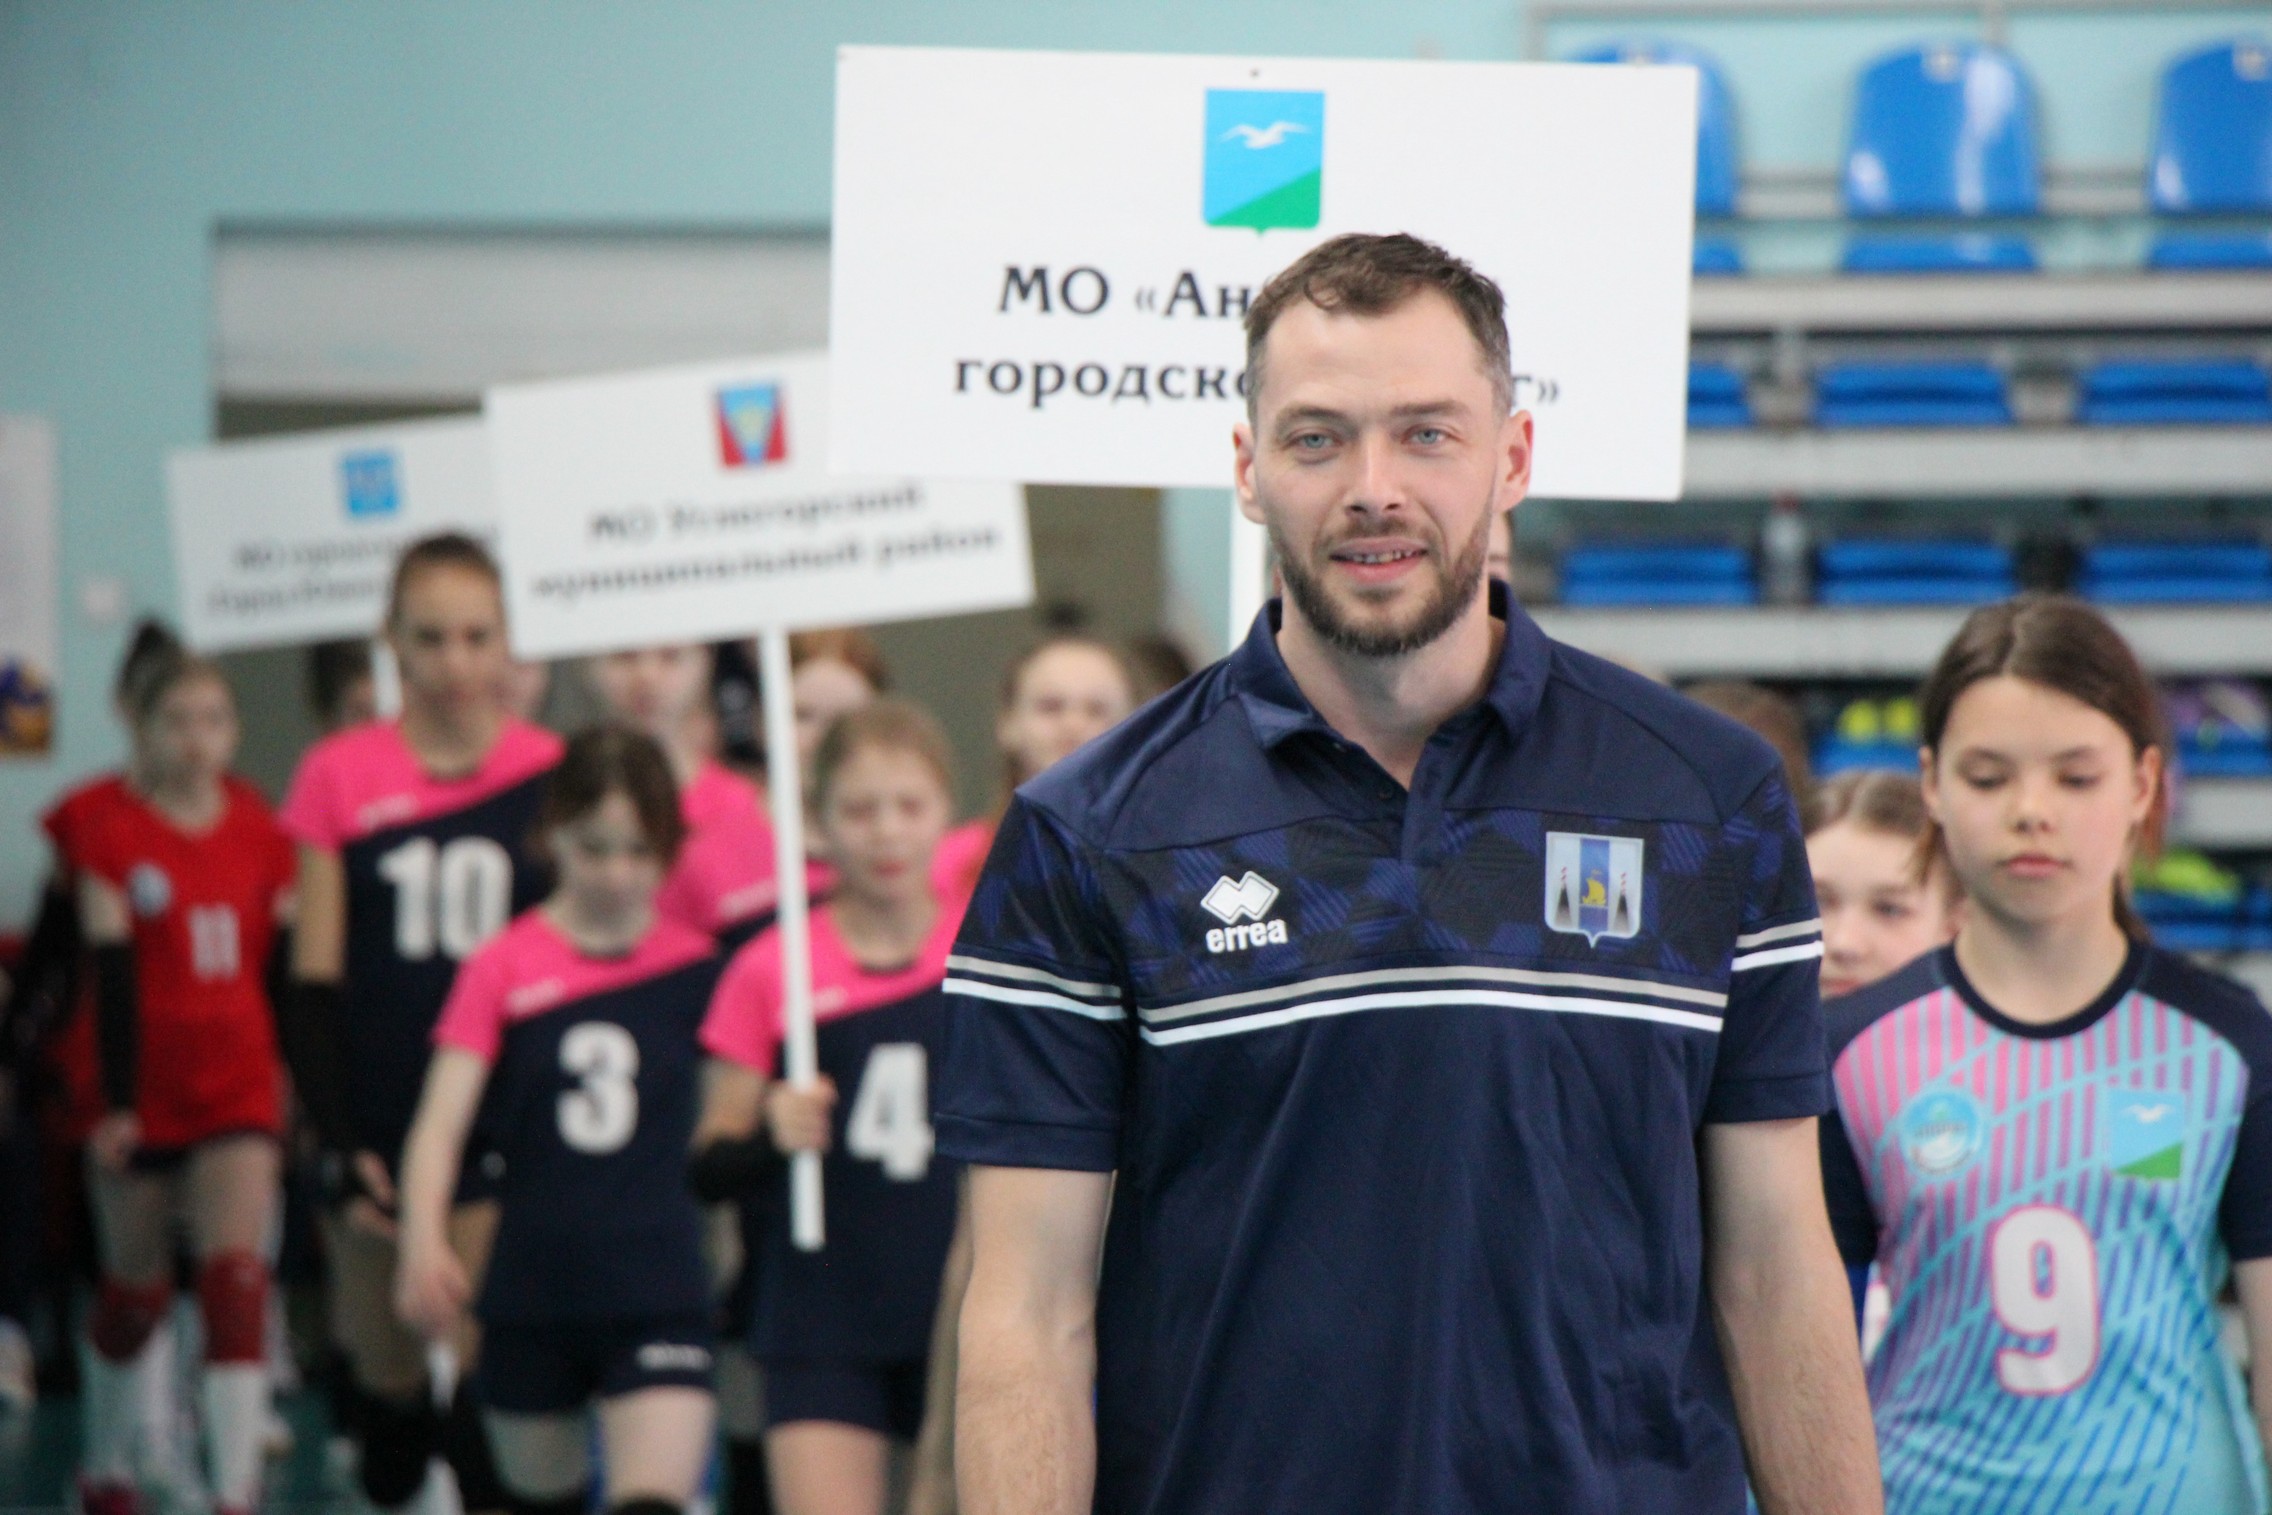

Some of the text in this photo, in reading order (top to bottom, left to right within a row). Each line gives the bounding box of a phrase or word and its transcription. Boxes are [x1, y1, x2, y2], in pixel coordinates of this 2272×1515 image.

[998, 266, 1250, 318] МО «Ан
[955, 360, 1248, 408] городск
[377, 836, 514, 961] 10
[1205, 917, 1288, 953] errea
[557, 1022, 640, 1154] 3
[846, 1043, 936, 1181] 4
[1991, 1204, 2098, 1397] 9
